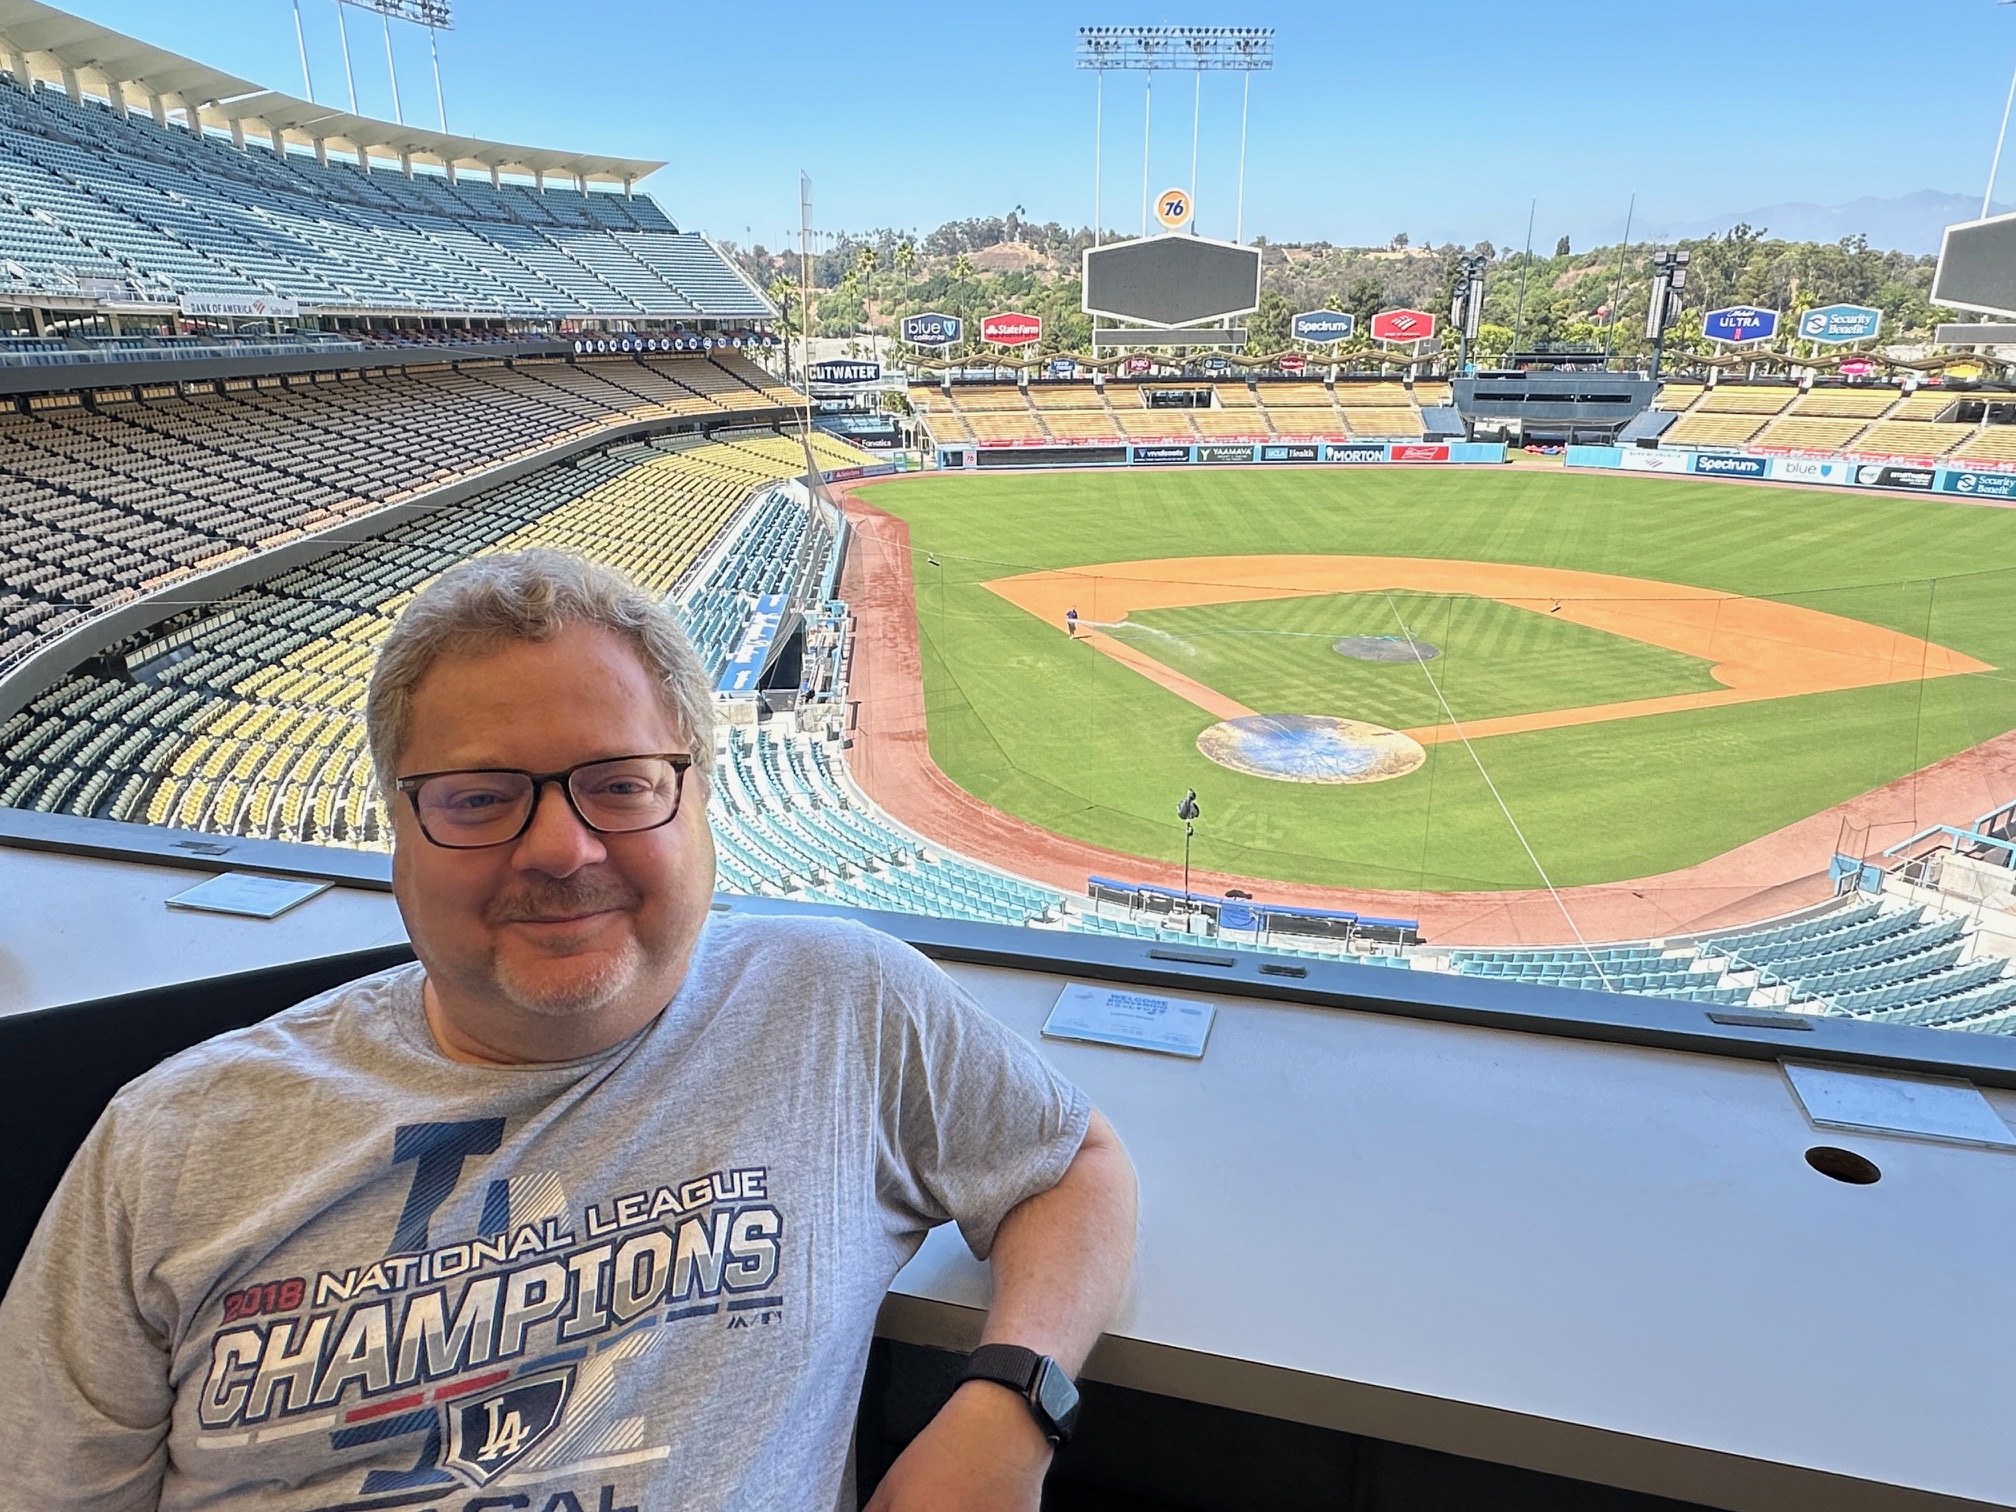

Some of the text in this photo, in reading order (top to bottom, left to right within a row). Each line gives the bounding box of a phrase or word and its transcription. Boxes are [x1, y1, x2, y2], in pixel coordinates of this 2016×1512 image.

[1165, 199, 1184, 217] 76
[190, 303, 253, 314] BANK OF AMERICA
[1719, 317, 1760, 328] ULTRA
[1829, 313, 1873, 326] Security
[908, 319, 941, 335] blue
[1297, 320, 1345, 333] Spectrum
[1828, 324, 1866, 335] Benefit
[808, 365, 876, 379] CUTWATER
[862, 438, 891, 447] Fanatics
[1288, 449, 1314, 458] Health
[1333, 450, 1384, 461] MORTON
[1698, 457, 1755, 472] Spectrum
[1786, 462, 1817, 475] blue
[1978, 475, 2015, 487] Security
[1977, 485, 2009, 495] Benefit
[222, 1165, 770, 1327] 2018 NATIONAL LEAGUE
[197, 1203, 784, 1431] CHAMPIONS
[476, 1397, 531, 1462] LA
